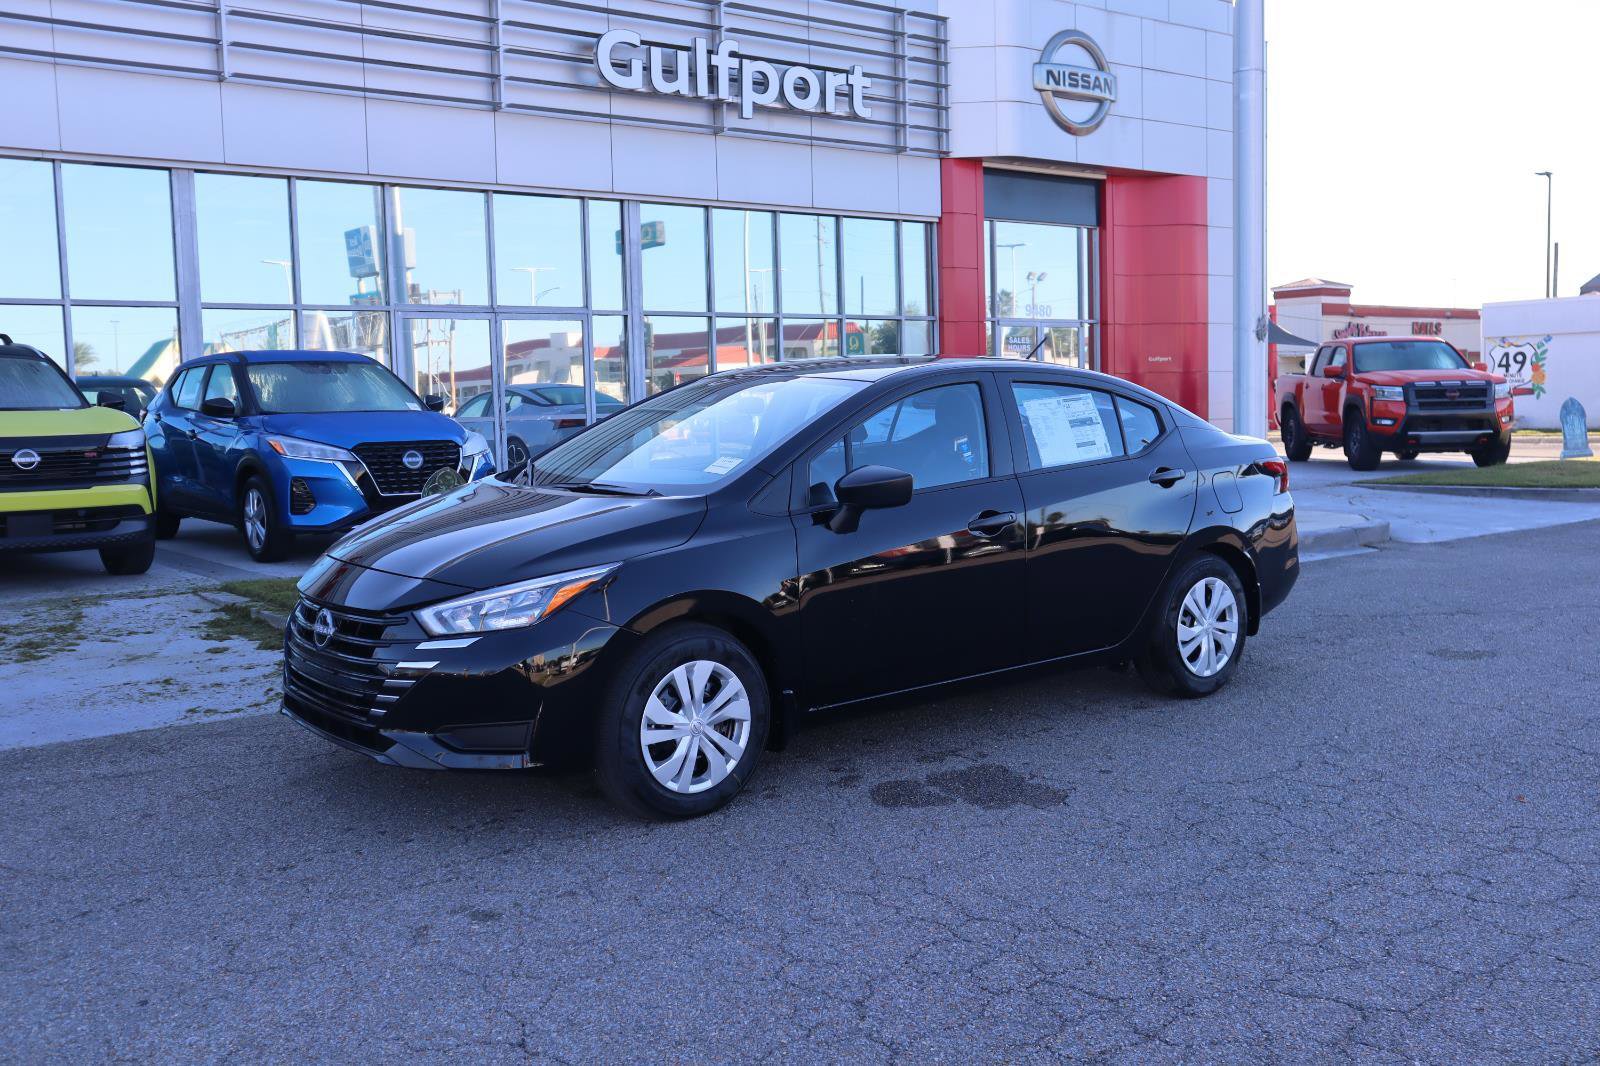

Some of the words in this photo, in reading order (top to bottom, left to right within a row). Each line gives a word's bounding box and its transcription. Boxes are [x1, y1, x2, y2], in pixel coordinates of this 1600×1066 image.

[597, 29, 872, 119] Gulfport
[1046, 69, 1113, 95] NISSAN
[1412, 321, 1442, 336] NAILS
[1008, 336, 1030, 344] SALES
[1008, 344, 1031, 352] HOURS
[1497, 352, 1527, 373] 49
